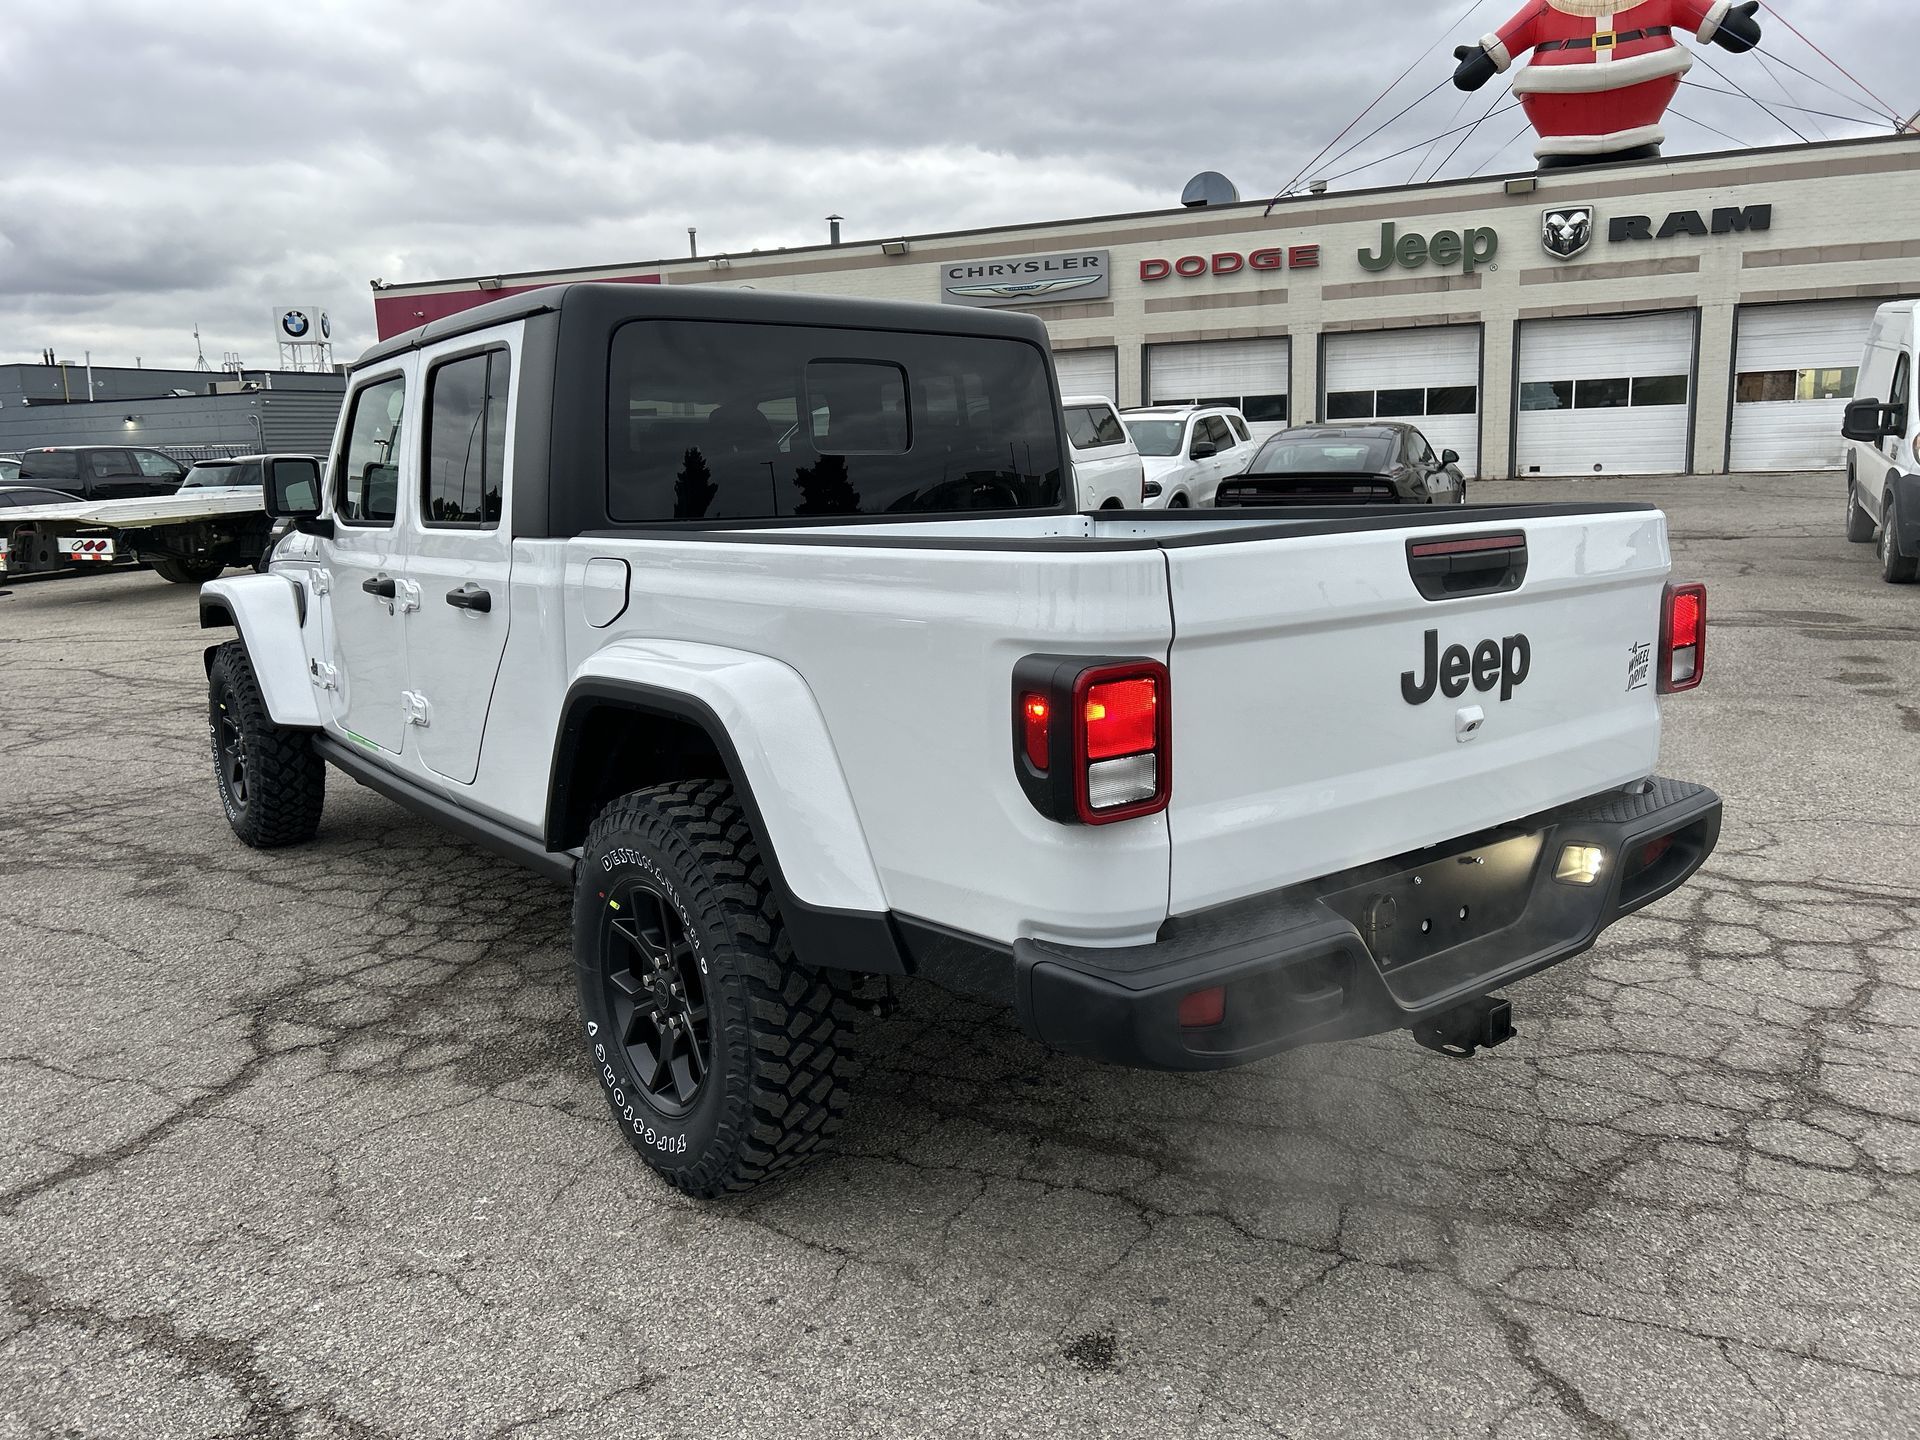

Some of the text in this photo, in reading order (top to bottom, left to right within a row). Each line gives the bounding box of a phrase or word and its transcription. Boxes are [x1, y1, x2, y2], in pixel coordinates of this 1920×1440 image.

[1608, 204, 1772, 242] RAM
[1139, 244, 1320, 281] DODGE
[1357, 222, 1498, 273] Jeep
[949, 256, 1099, 279] CHRYSLER
[1401, 628, 1531, 705] Jeep
[1626, 664, 1648, 691] DRIVE
[1628, 649, 1650, 674] WHEEL
[601, 848, 700, 950] DESTINATION
